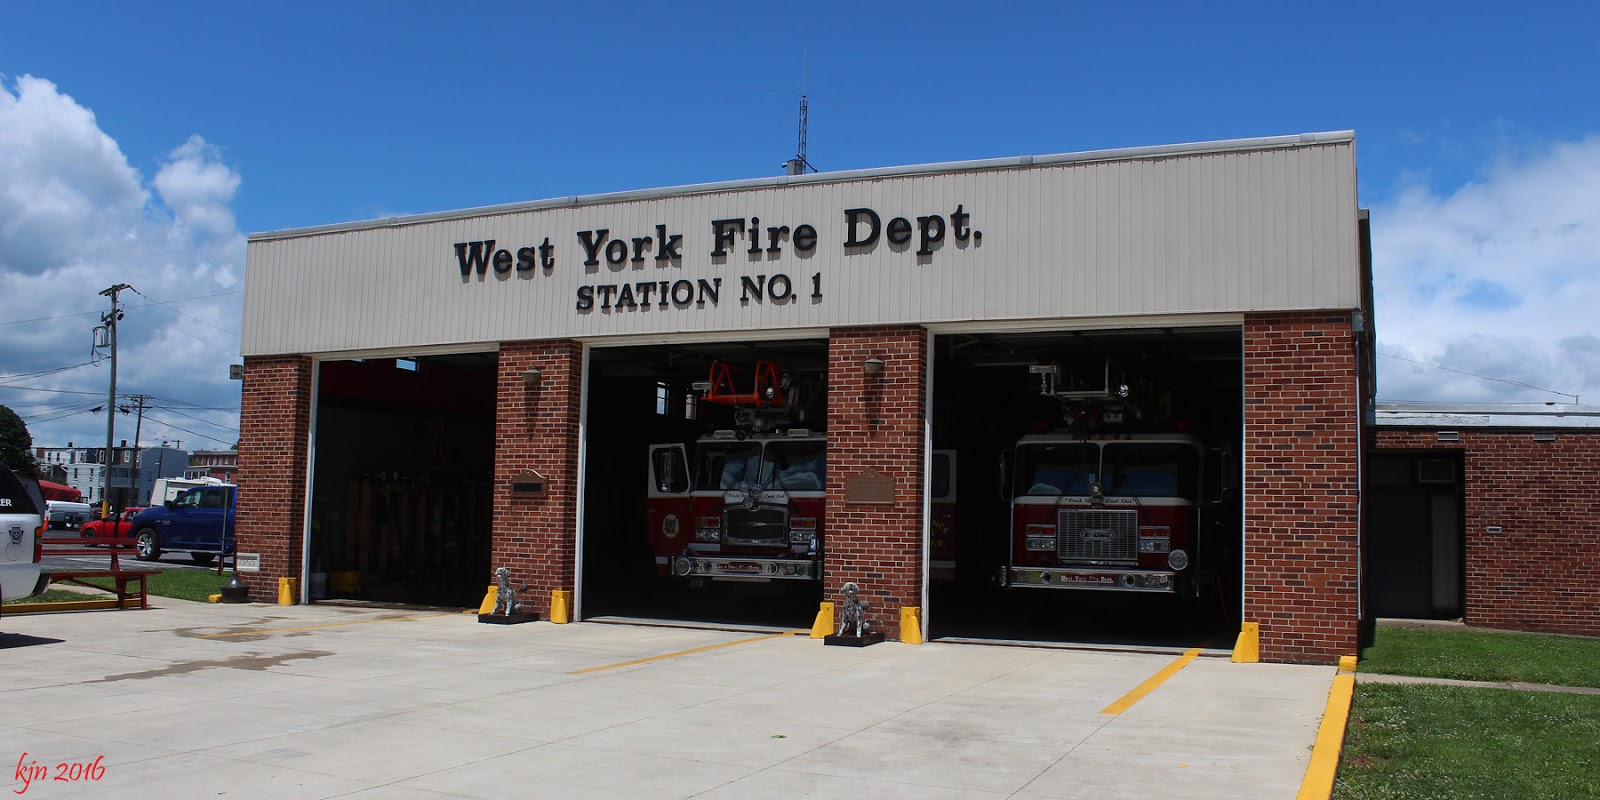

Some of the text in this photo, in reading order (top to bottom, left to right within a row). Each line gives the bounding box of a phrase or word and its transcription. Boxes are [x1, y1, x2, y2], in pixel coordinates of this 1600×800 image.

[454, 204, 982, 276] West York Fire Dept.
[577, 272, 823, 310] STATION NO. 1
